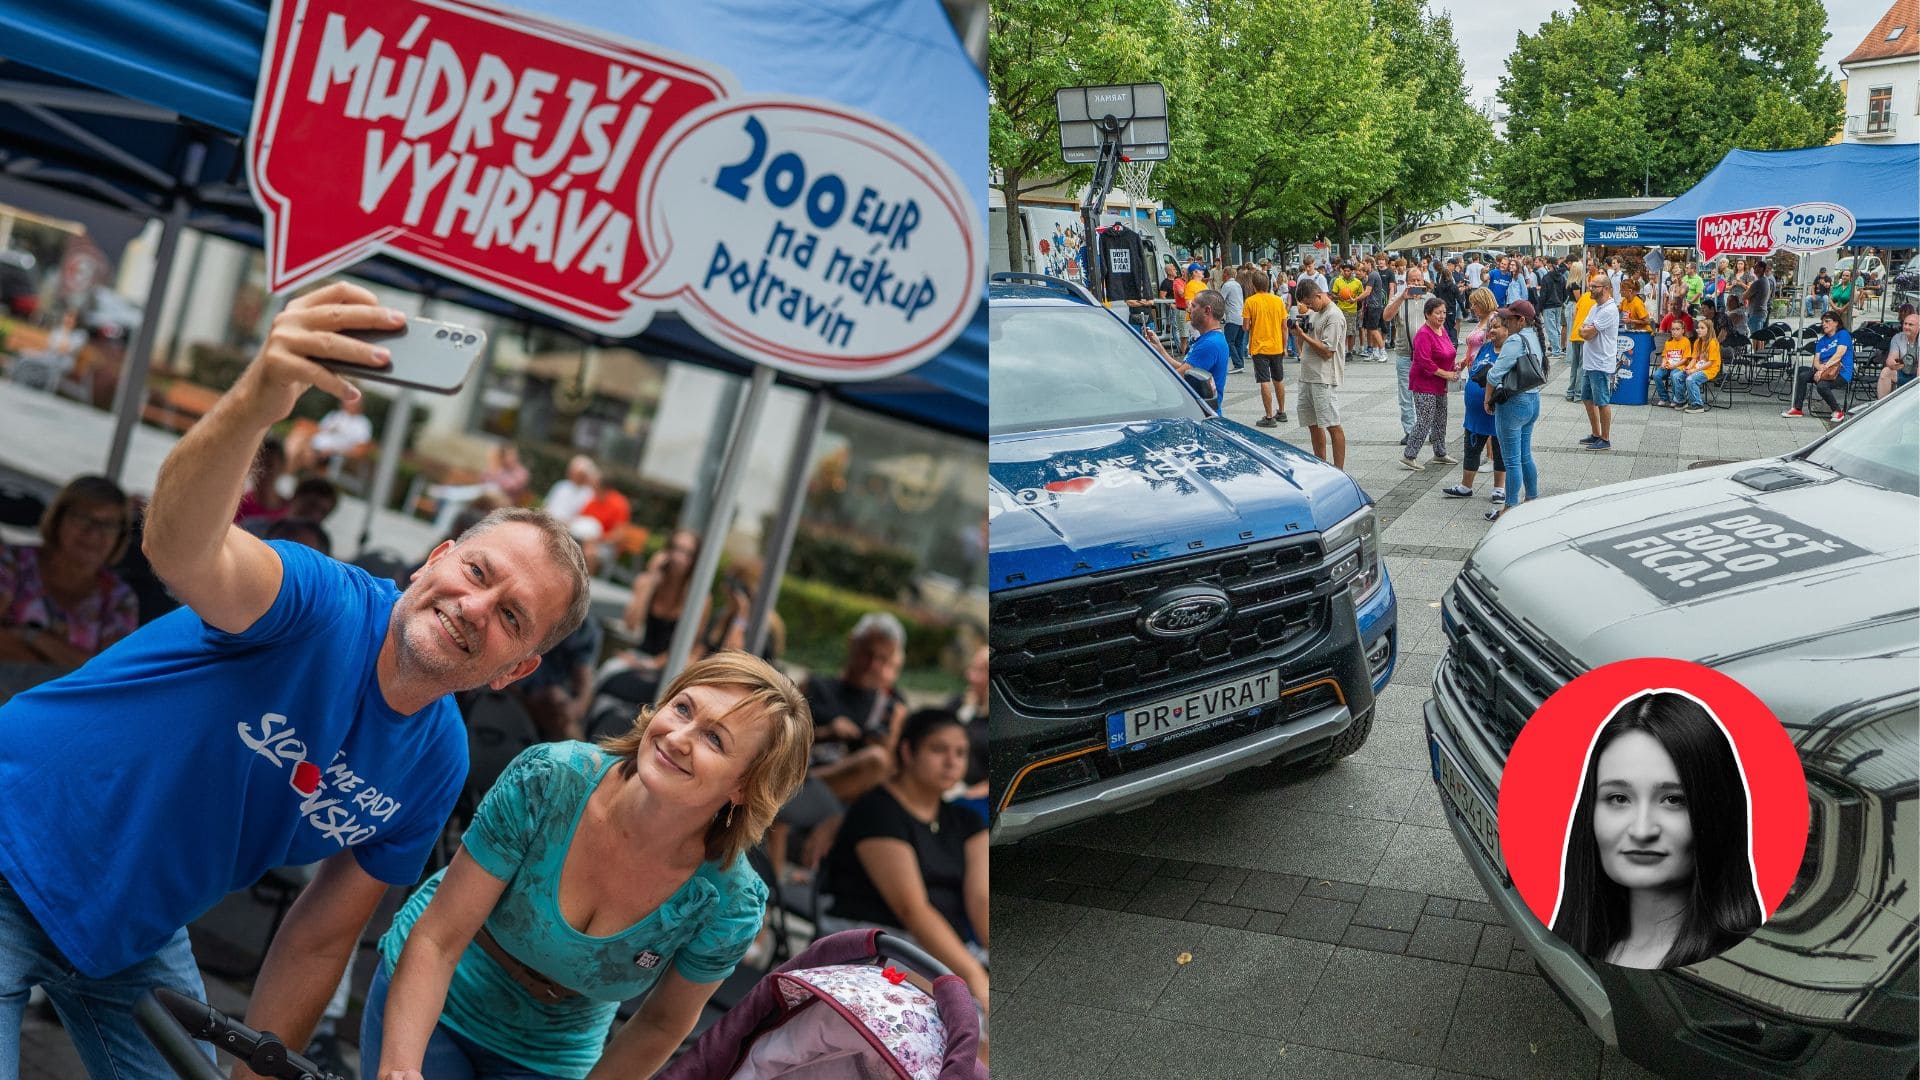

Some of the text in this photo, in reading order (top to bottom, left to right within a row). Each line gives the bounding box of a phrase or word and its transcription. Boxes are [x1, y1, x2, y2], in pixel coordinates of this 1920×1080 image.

[306, 11, 672, 193] MÚDREJŠÍ
[358, 129, 633, 284] VYHRÁVA
[714, 114, 922, 250] 200 EUR
[1599, 231, 1639, 239] SLOVENSKO
[1704, 211, 1769, 237] MÚDREJŠÍ
[1715, 231, 1768, 250] VYHRÁVA
[1784, 211, 1835, 227] 200 EUR
[1799, 223, 1845, 237] na nákup
[703, 240, 856, 348] potravín
[765, 219, 937, 323] na nákup
[1005, 521, 1300, 584] RANGER
[1662, 524, 1780, 573] BOLO
[1708, 514, 1844, 558] DOSŤ
[1612, 535, 1733, 588] FICA!
[1167, 604, 1211, 629] Ford
[1111, 732, 1125, 744] SK
[1185, 675, 1270, 722] EVRAT
[351, 786, 402, 822] RADI
